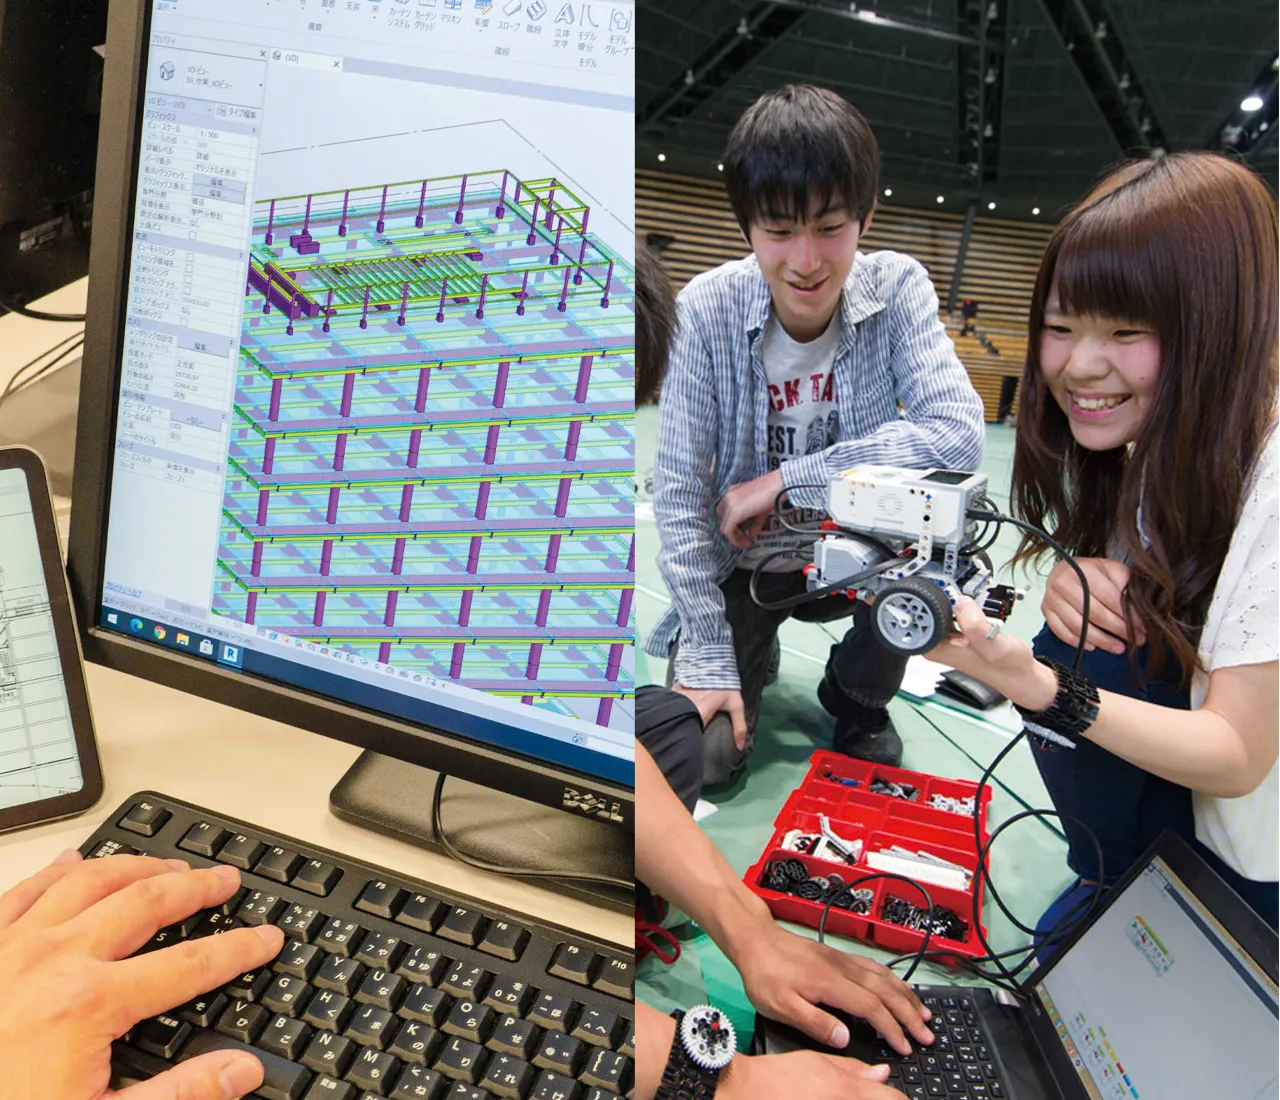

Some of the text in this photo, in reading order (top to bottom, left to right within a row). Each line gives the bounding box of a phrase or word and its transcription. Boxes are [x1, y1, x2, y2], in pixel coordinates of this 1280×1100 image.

[345, 1, 361, 11] 天井
[389, 7, 412, 18] カーテン
[414, 10, 437, 21] カーテン
[387, 18, 411, 29] システム
[440, 13, 463, 25] マリオン
[413, 20, 436, 32] グリッド
[497, 20, 521, 32] スロープ
[525, 24, 542, 35] 階段
[555, 28, 571, 38] 立体
[578, 31, 597, 42] モデル
[552, 39, 569, 49] 文字
[609, 35, 629, 46] モデル
[604, 45, 630, 57] グループ
[579, 58, 598, 69] モデル
[810, 373, 840, 404] TA
[562, 787, 625, 824] DELL
[199, 822, 210, 831] F1
[235, 835, 247, 843] F2
[273, 846, 285, 855] F3
[311, 859, 322, 869] F4
[375, 881, 387, 890] F5
[415, 895, 427, 904] F6
[245, 902, 255, 910] 4
[455, 908, 467, 916] F7
[209, 913, 221, 923] E
[284, 915, 293, 924] 5
[496, 922, 508, 931] F8
[156, 932, 167, 942] S
[325, 930, 333, 938] 6
[292, 941, 303, 951] T
[366, 944, 376, 952] 7
[567, 945, 579, 954] F9
[377, 948, 388, 957] や
[293, 956, 305, 966] か
[333, 956, 345, 966] Y
[407, 959, 416, 967] 8
[611, 960, 628, 970] F10
[418, 962, 430, 971] ゆ
[242, 973, 255, 983] は
[334, 971, 347, 981] ん
[373, 971, 386, 981] U
[450, 974, 459, 982] 9
[278, 977, 291, 988] G
[462, 978, 474, 987] よ
[512, 982, 524, 991] を
[377, 986, 390, 996] な
[282, 993, 294, 1003] き
[319, 991, 333, 1003] H
[505, 993, 518, 1002] わ
[235, 1001, 248, 1012] V
[421, 1002, 434, 1013] に
[326, 1008, 337, 1018] く
[362, 1008, 373, 1018] J
[550, 1008, 564, 1018] ほ
[236, 1017, 249, 1027] ひ
[274, 1017, 287, 1028] B
[370, 1021, 383, 1030] ま
[466, 1018, 477, 1027] ら
[504, 1017, 516, 1027] P
[406, 1023, 420, 1036] K
[279, 1034, 292, 1044] こ
[318, 1033, 333, 1046] N
[511, 1034, 523, 1044] せ
[412, 1041, 425, 1050] の
[451, 1039, 460, 1051] L
[323, 1050, 336, 1060] み
[363, 1049, 379, 1064] M
[460, 1057, 472, 1067] り
[370, 1068, 380, 1079] も
[504, 1073, 517, 1084] れ
[414, 1084, 427, 1096] ね
